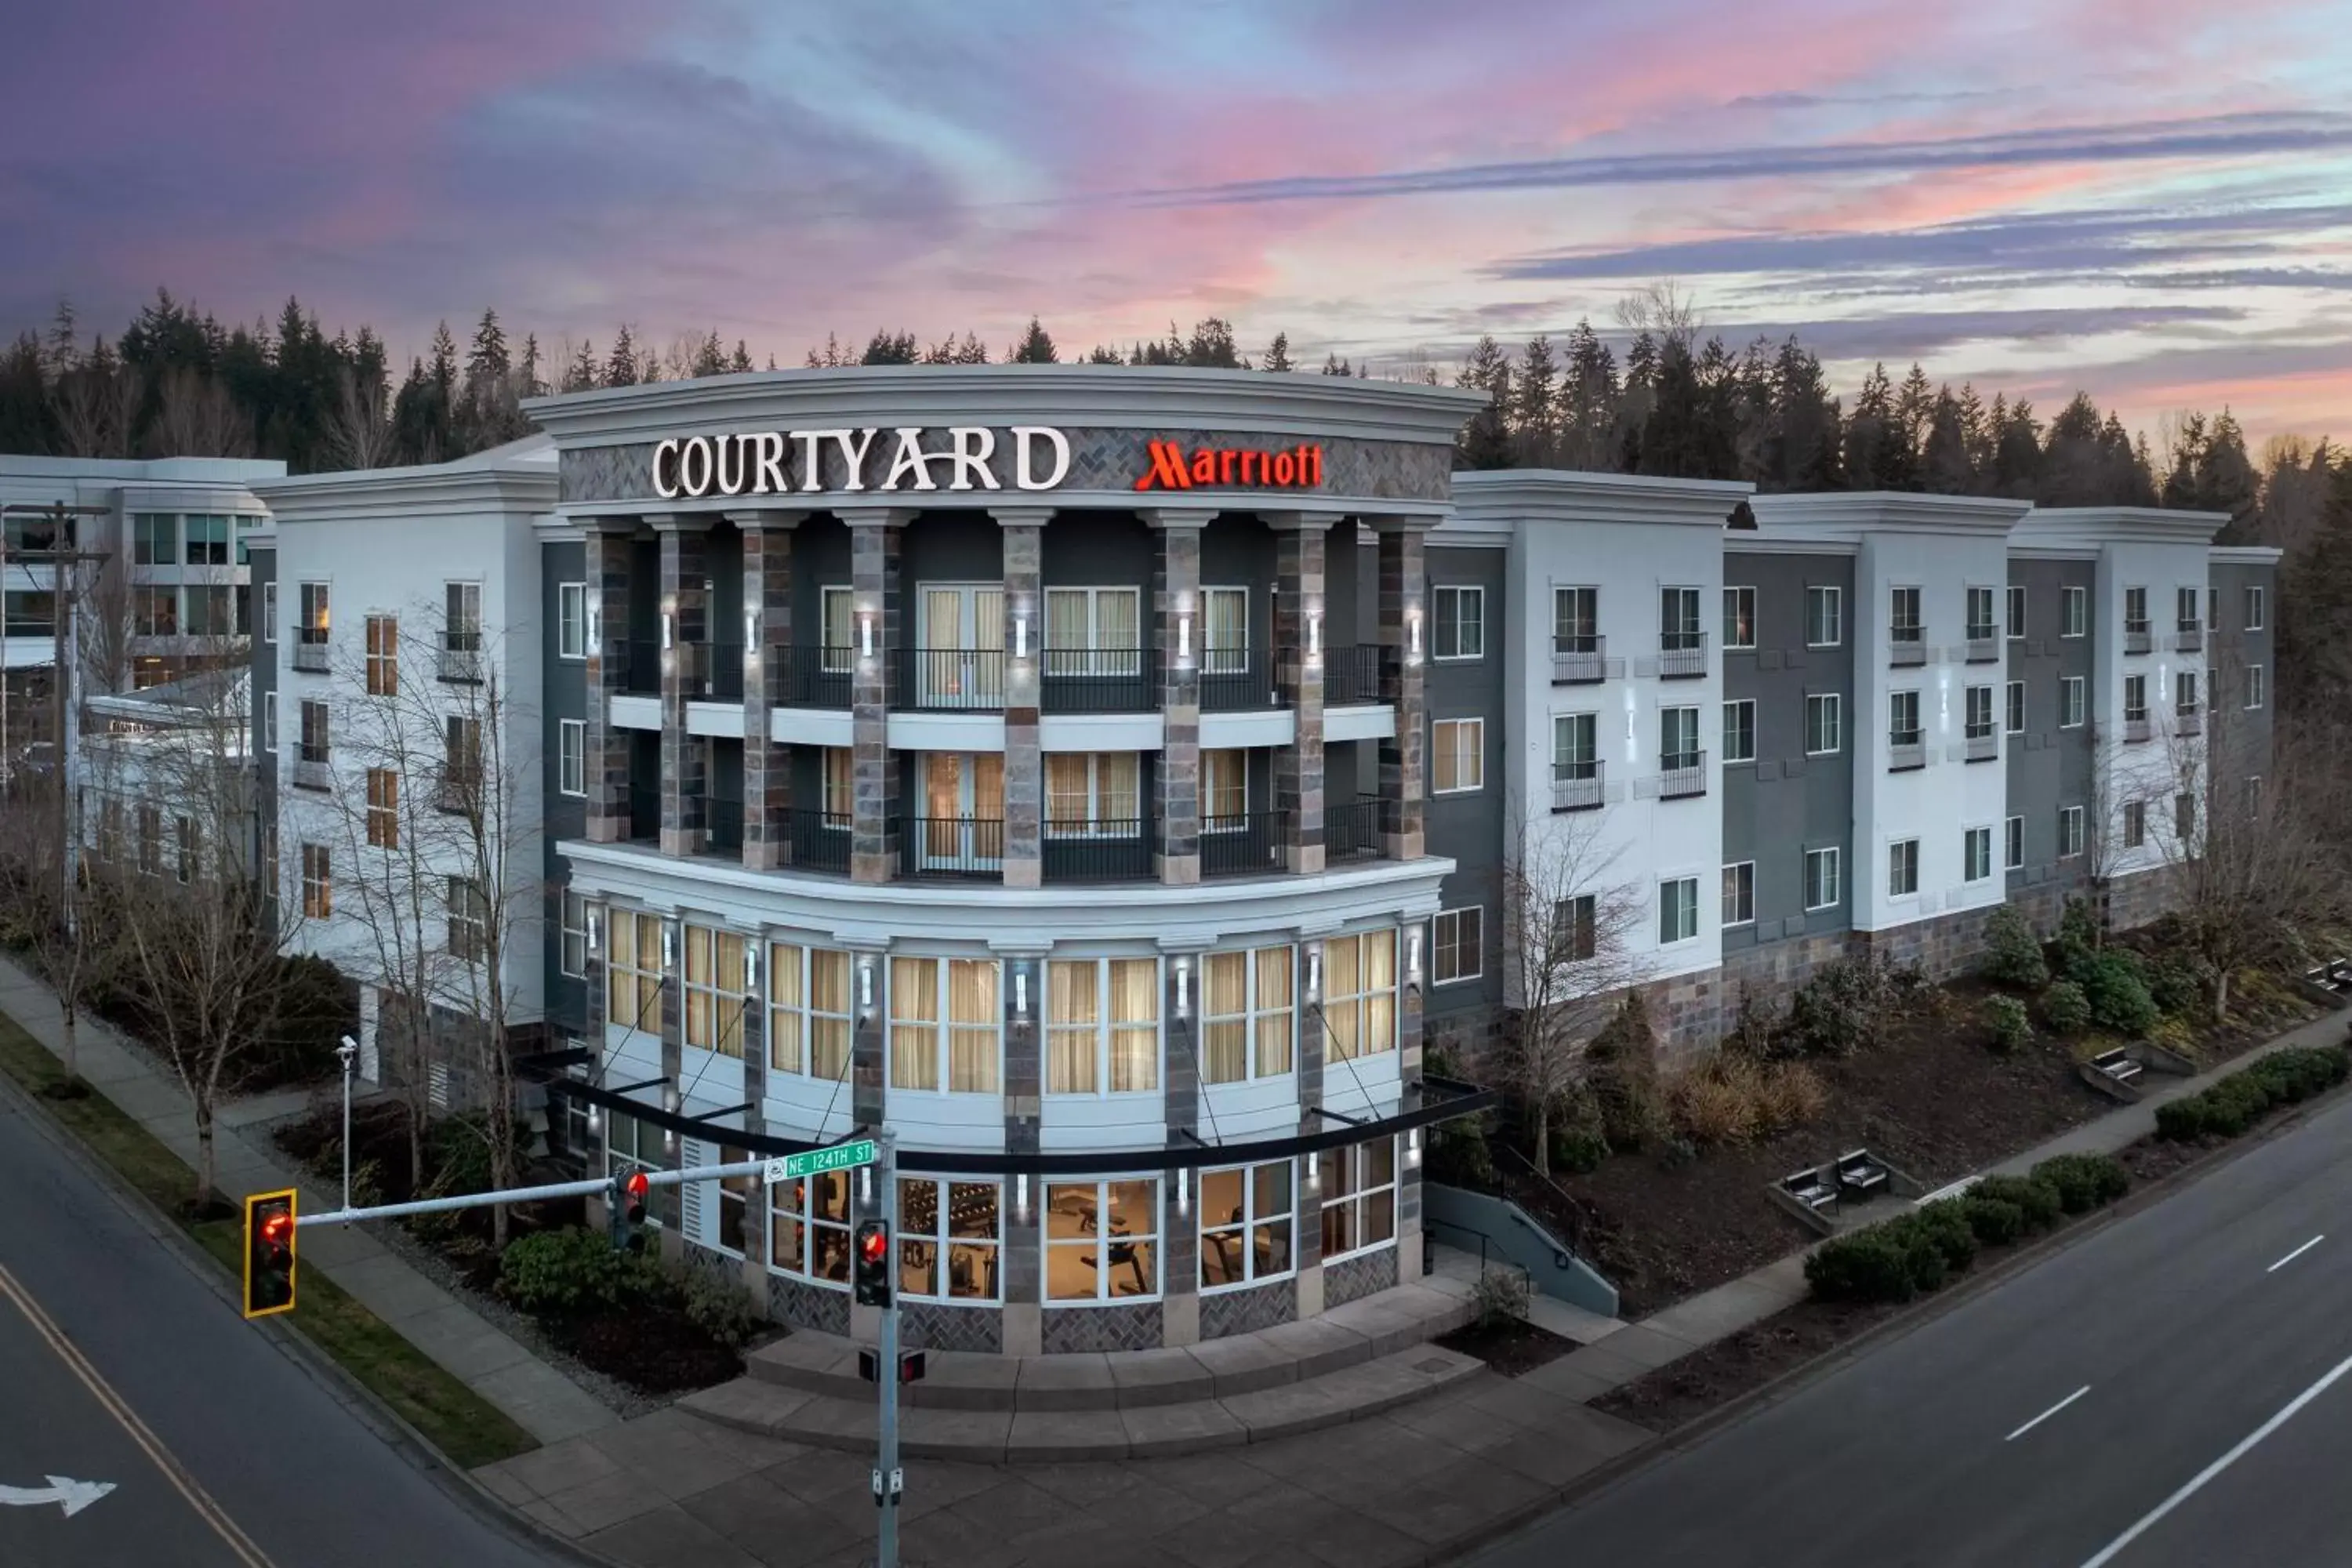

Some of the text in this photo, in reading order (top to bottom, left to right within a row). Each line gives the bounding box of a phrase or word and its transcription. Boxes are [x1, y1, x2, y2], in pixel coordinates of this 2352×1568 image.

[652, 426, 1070, 499] COURTYARD
[1134, 439, 1322, 492] Marriott
[789, 1157, 804, 1175] NE
[813, 1149, 848, 1169] 124TH
[855, 1144, 870, 1161] ST
